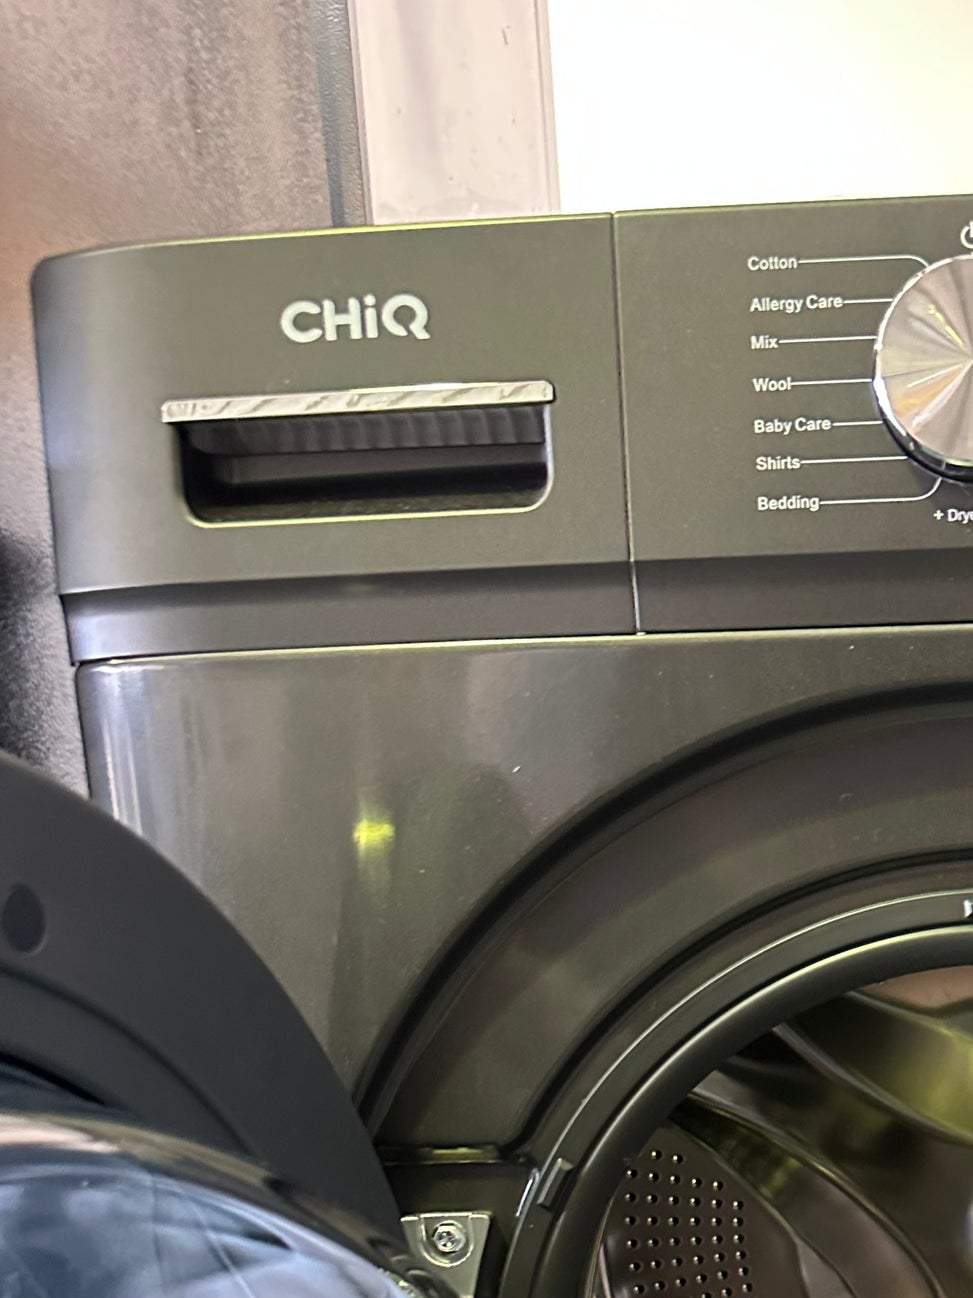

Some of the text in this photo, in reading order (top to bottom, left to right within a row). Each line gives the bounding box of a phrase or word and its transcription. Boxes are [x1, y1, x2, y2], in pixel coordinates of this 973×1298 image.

[748, 256, 798, 271] Cotton
[750, 294, 843, 313] Allergy Care
[280, 293, 431, 343] CHiQ
[751, 335, 778, 349] Mix
[752, 377, 792, 391] Wool
[754, 417, 831, 435] Baby Care
[756, 456, 801, 470] Shirts
[757, 495, 820, 512] Bedding
